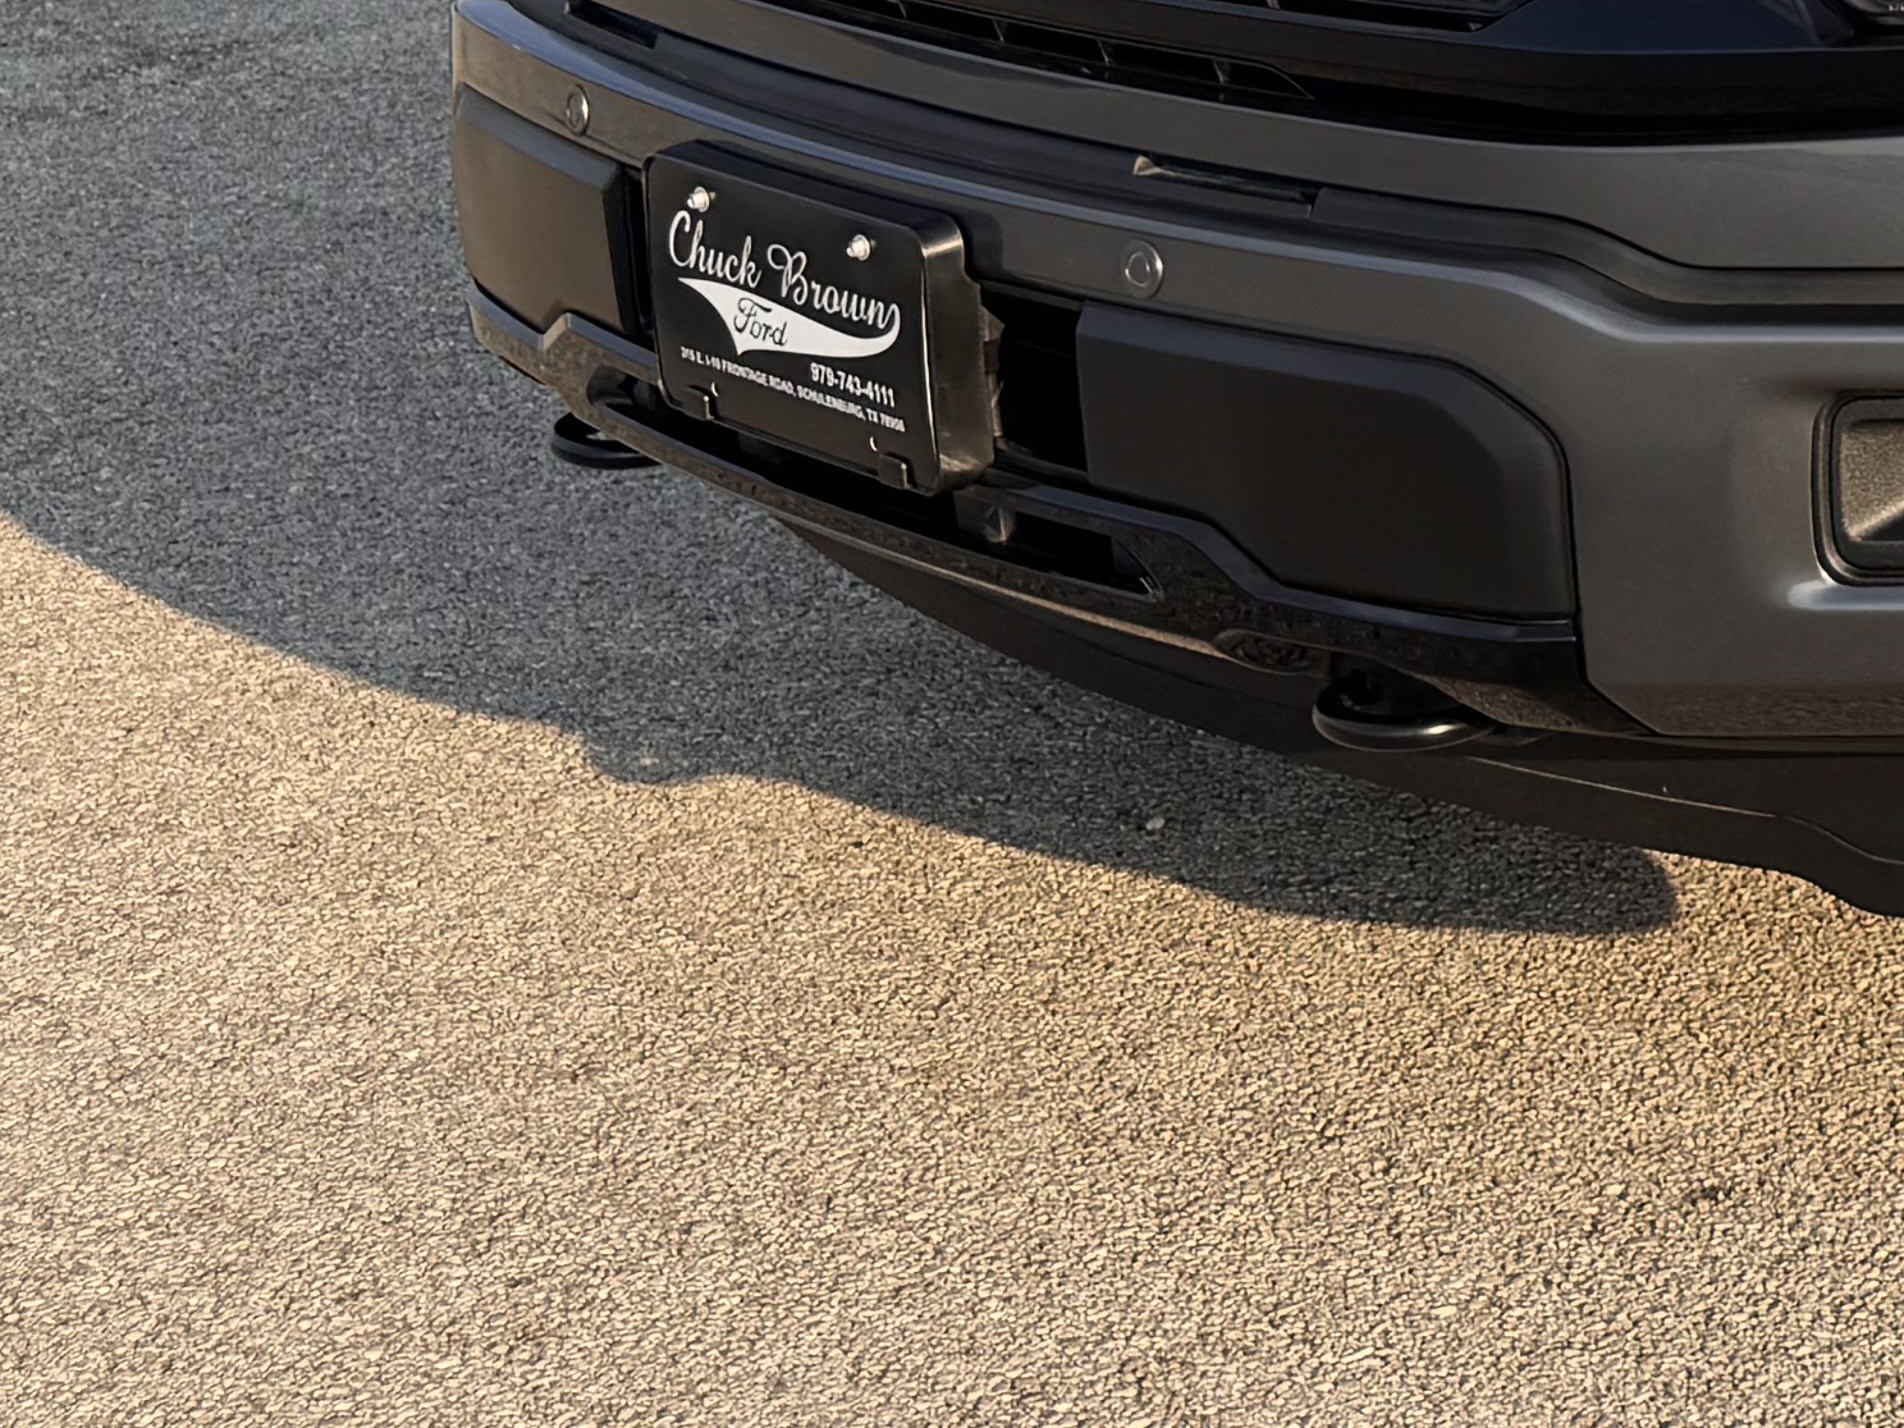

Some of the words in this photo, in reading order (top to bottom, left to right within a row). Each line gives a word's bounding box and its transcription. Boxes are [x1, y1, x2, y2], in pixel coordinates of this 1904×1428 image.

[669, 210, 763, 289] Chuck
[767, 243, 898, 331] Brown
[733, 296, 788, 347] Ford
[810, 362, 896, 408] 979-743-4111
